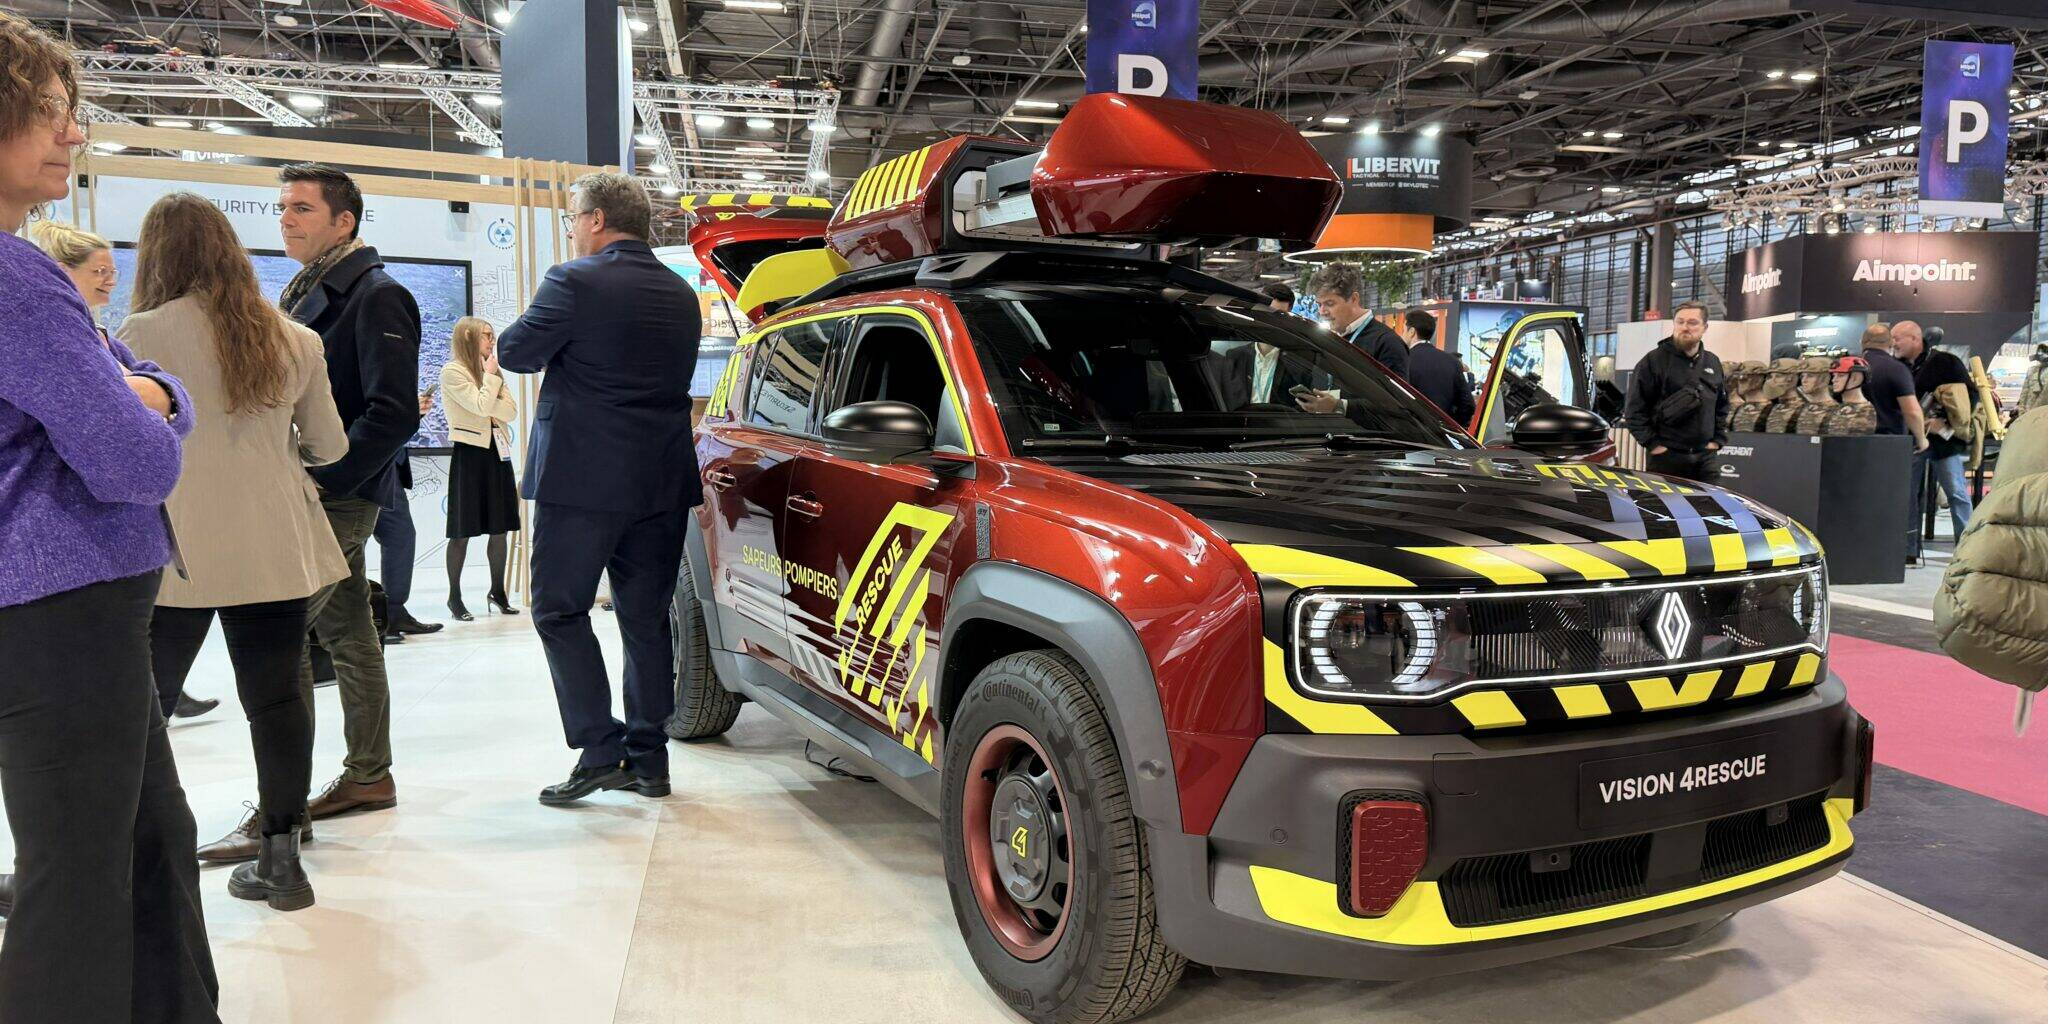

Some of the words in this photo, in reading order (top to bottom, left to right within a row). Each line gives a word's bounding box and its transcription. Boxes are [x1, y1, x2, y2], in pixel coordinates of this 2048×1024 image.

[1947, 100, 1989, 163] P
[1352, 157, 1441, 175] LIBERVIT
[742, 544, 781, 577] SAPEURS
[784, 559, 838, 600] POMPIERS
[855, 534, 904, 626] RESCUE
[1599, 771, 1675, 804] VISION
[1679, 753, 1767, 792] 4RESCUE
